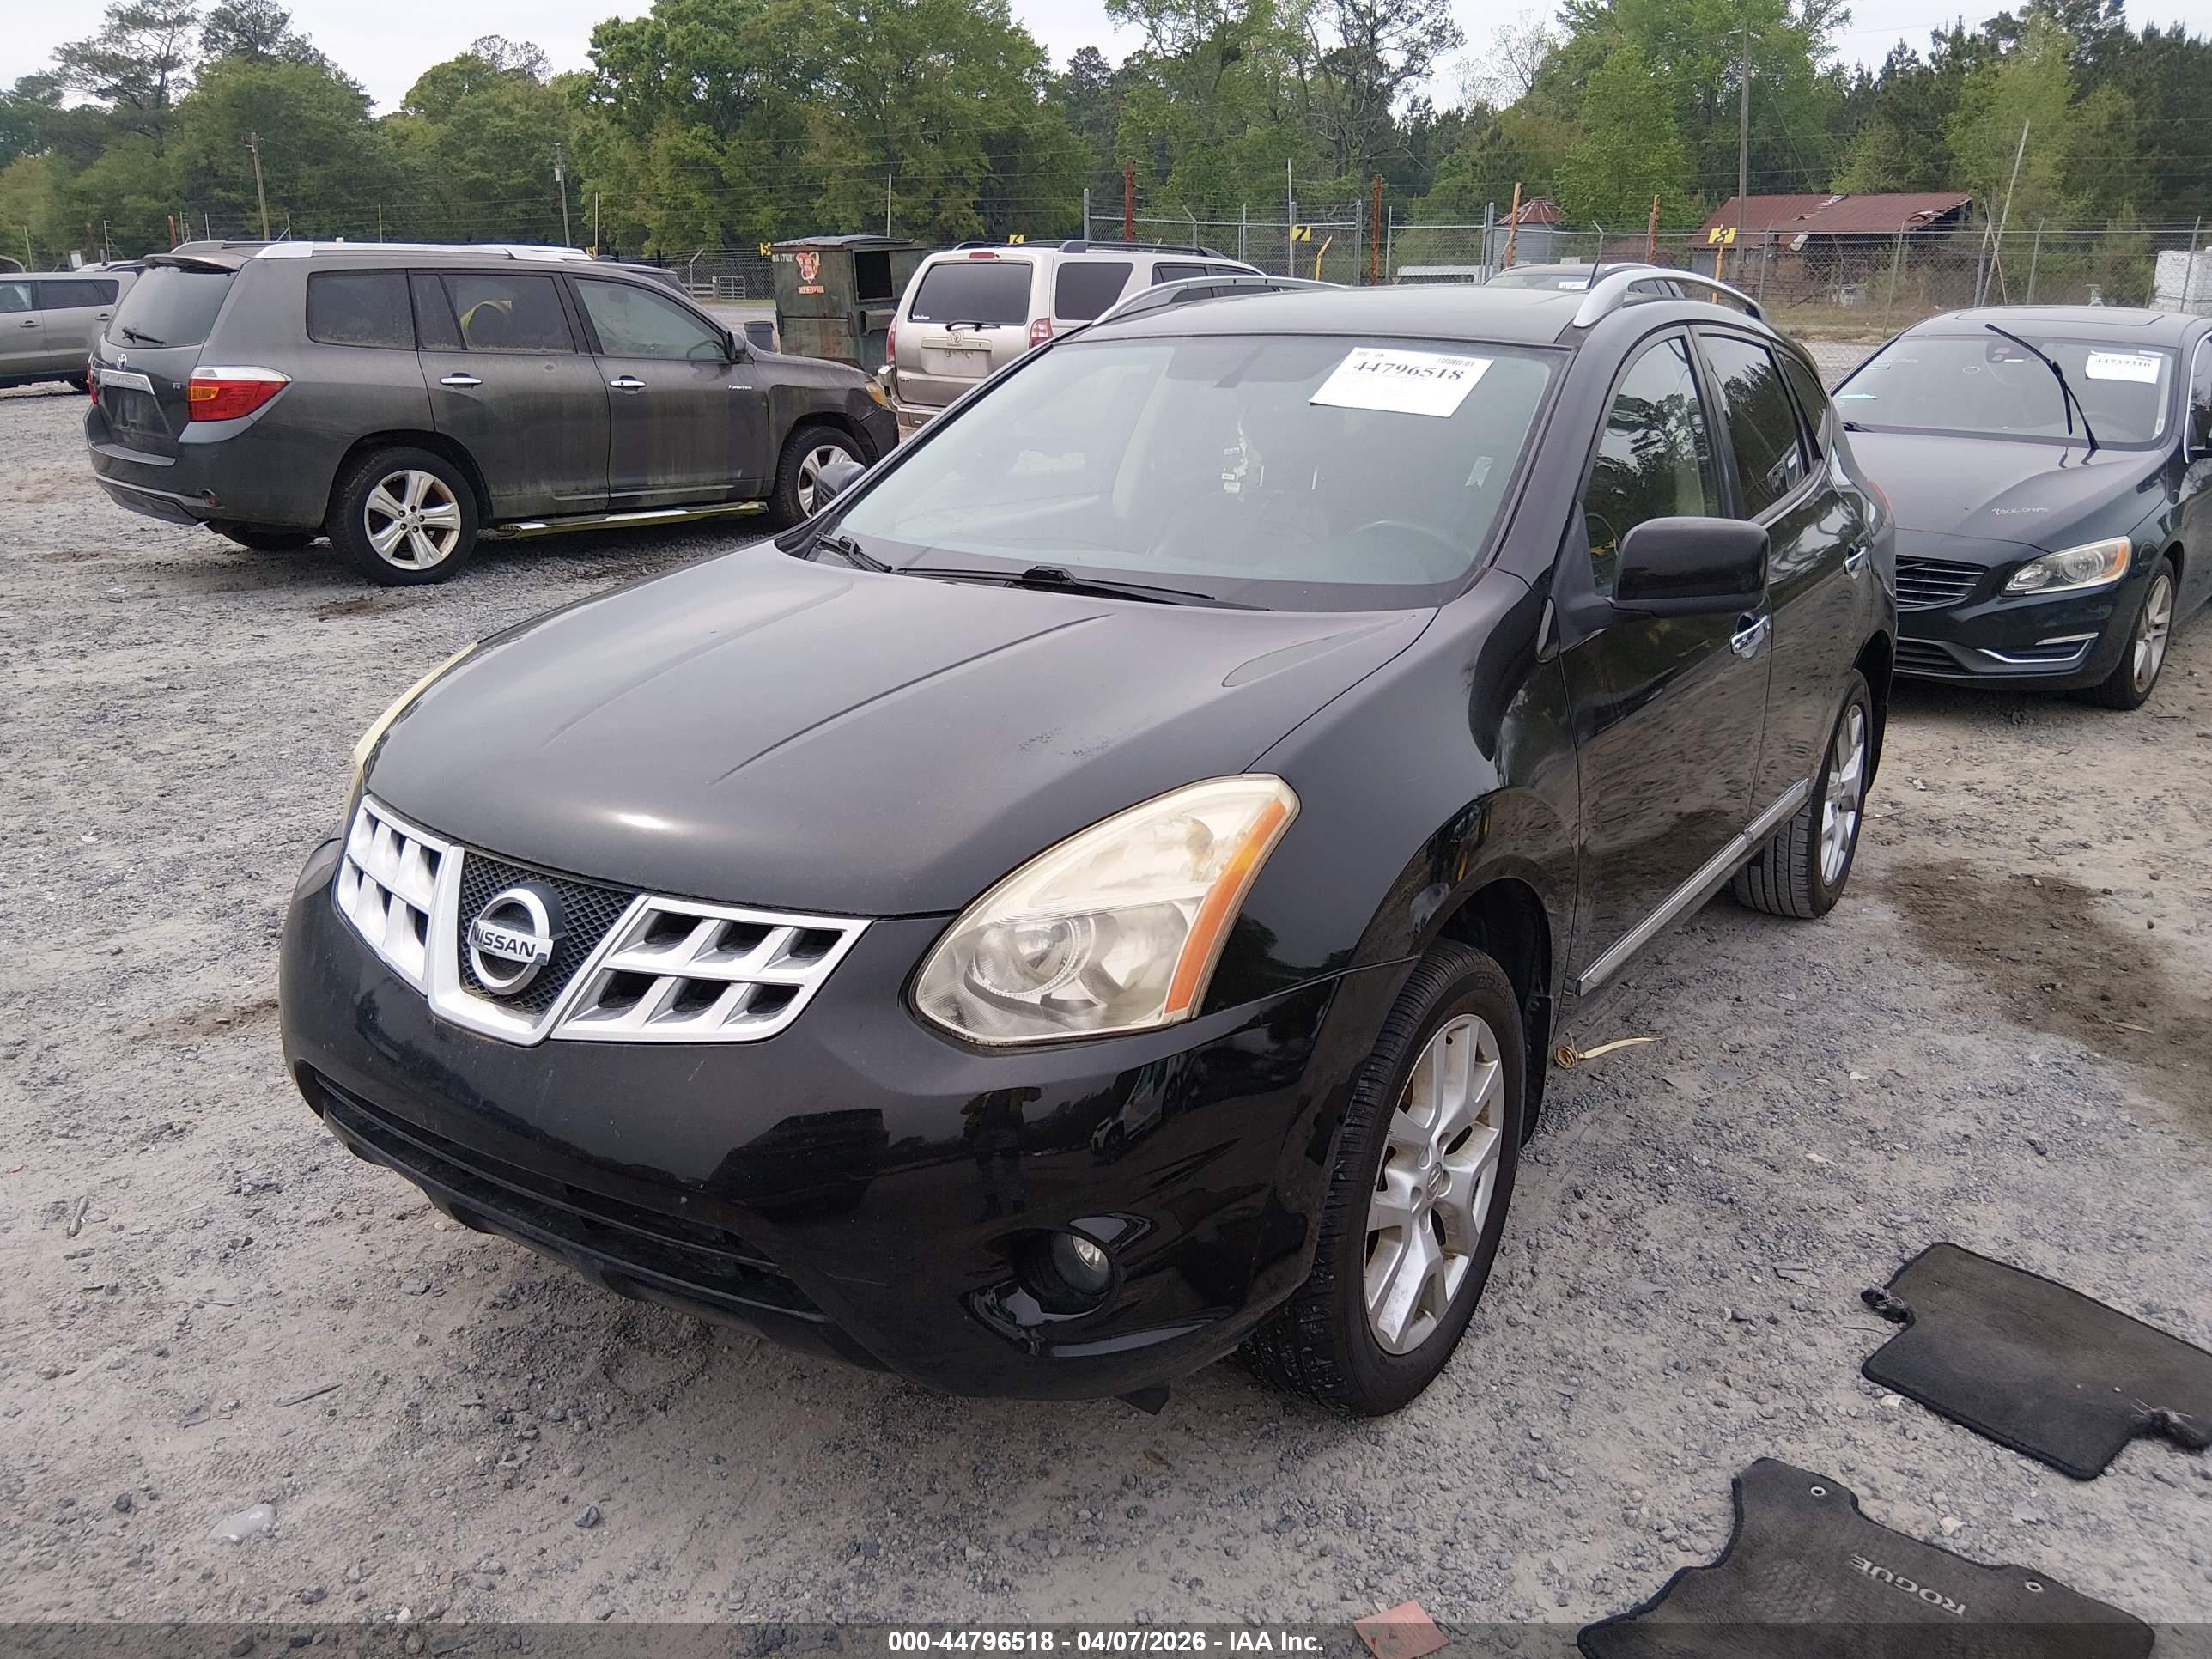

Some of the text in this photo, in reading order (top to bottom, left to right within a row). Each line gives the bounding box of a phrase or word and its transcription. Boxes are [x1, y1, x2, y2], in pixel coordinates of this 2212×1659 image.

[1296, 225, 1307, 241] 7
[1353, 361, 1464, 380] 44796518
[470, 921, 536, 958] NISSAN
[1850, 1554, 1966, 1615] ROGUE
